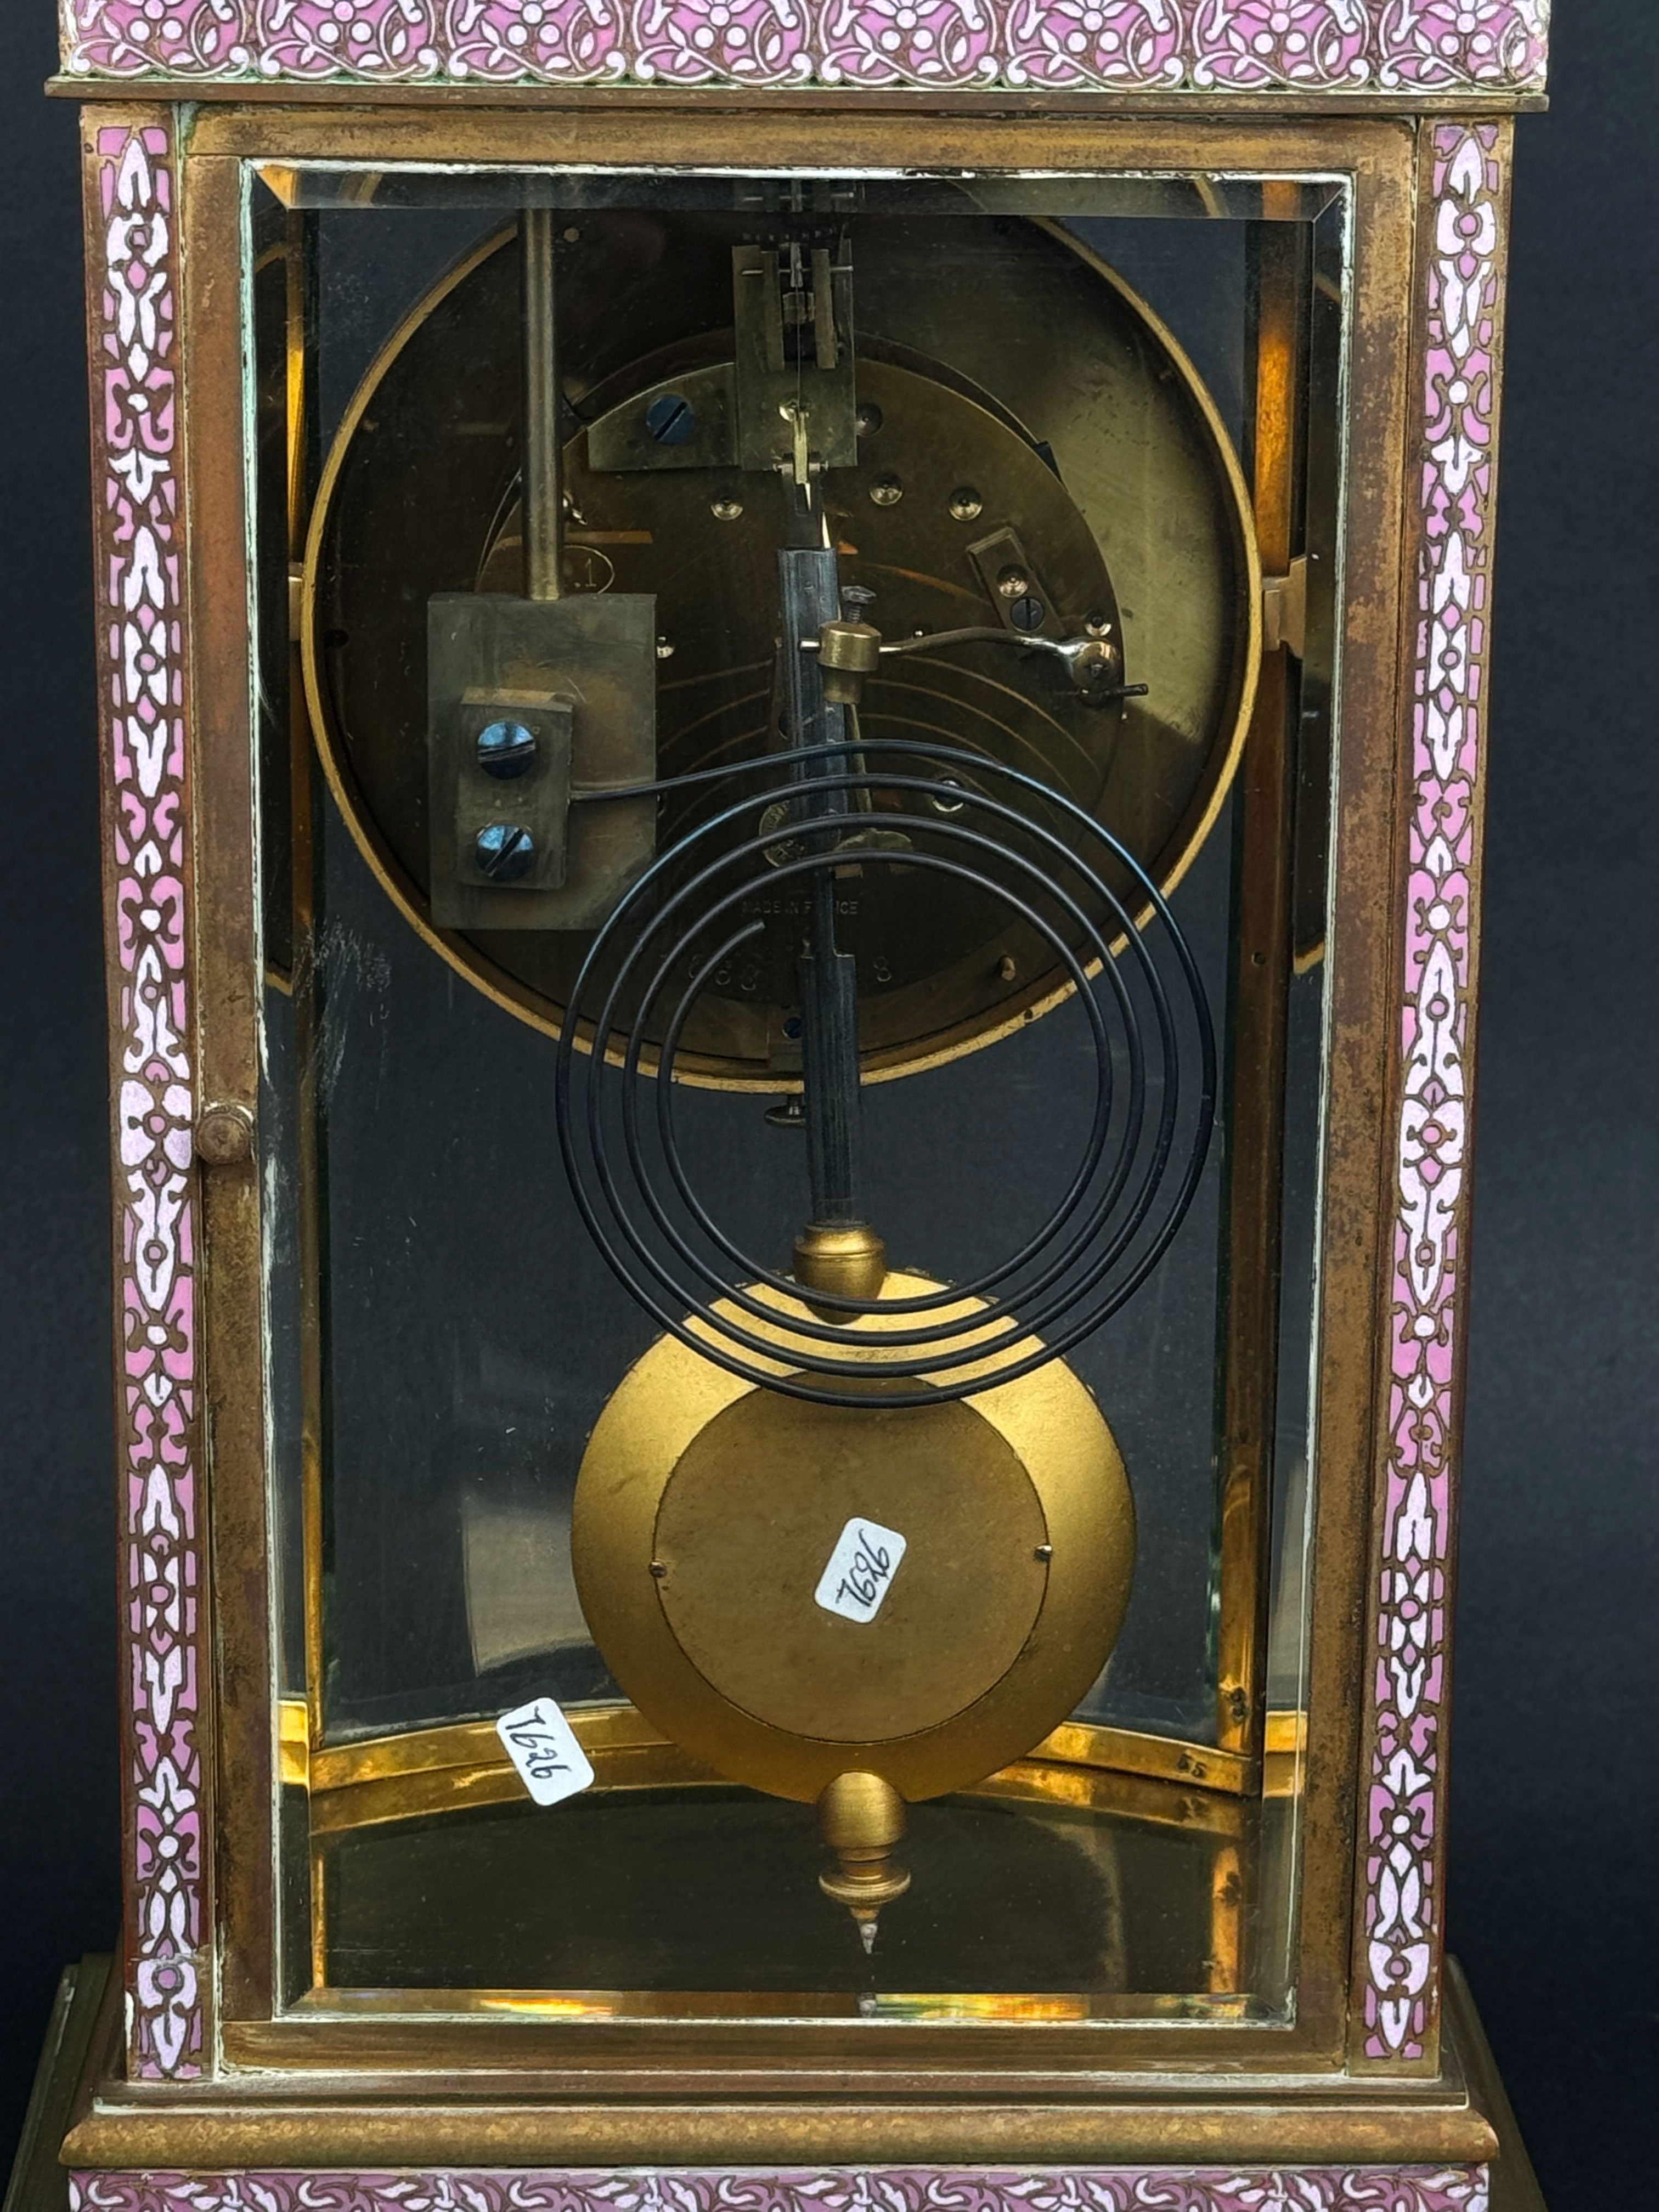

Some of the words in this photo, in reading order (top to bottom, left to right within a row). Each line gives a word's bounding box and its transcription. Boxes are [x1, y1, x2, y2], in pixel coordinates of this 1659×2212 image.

[742, 901, 781, 915] MADE
[785, 901, 799, 915] IN
[834, 1528, 890, 1607] 7626
